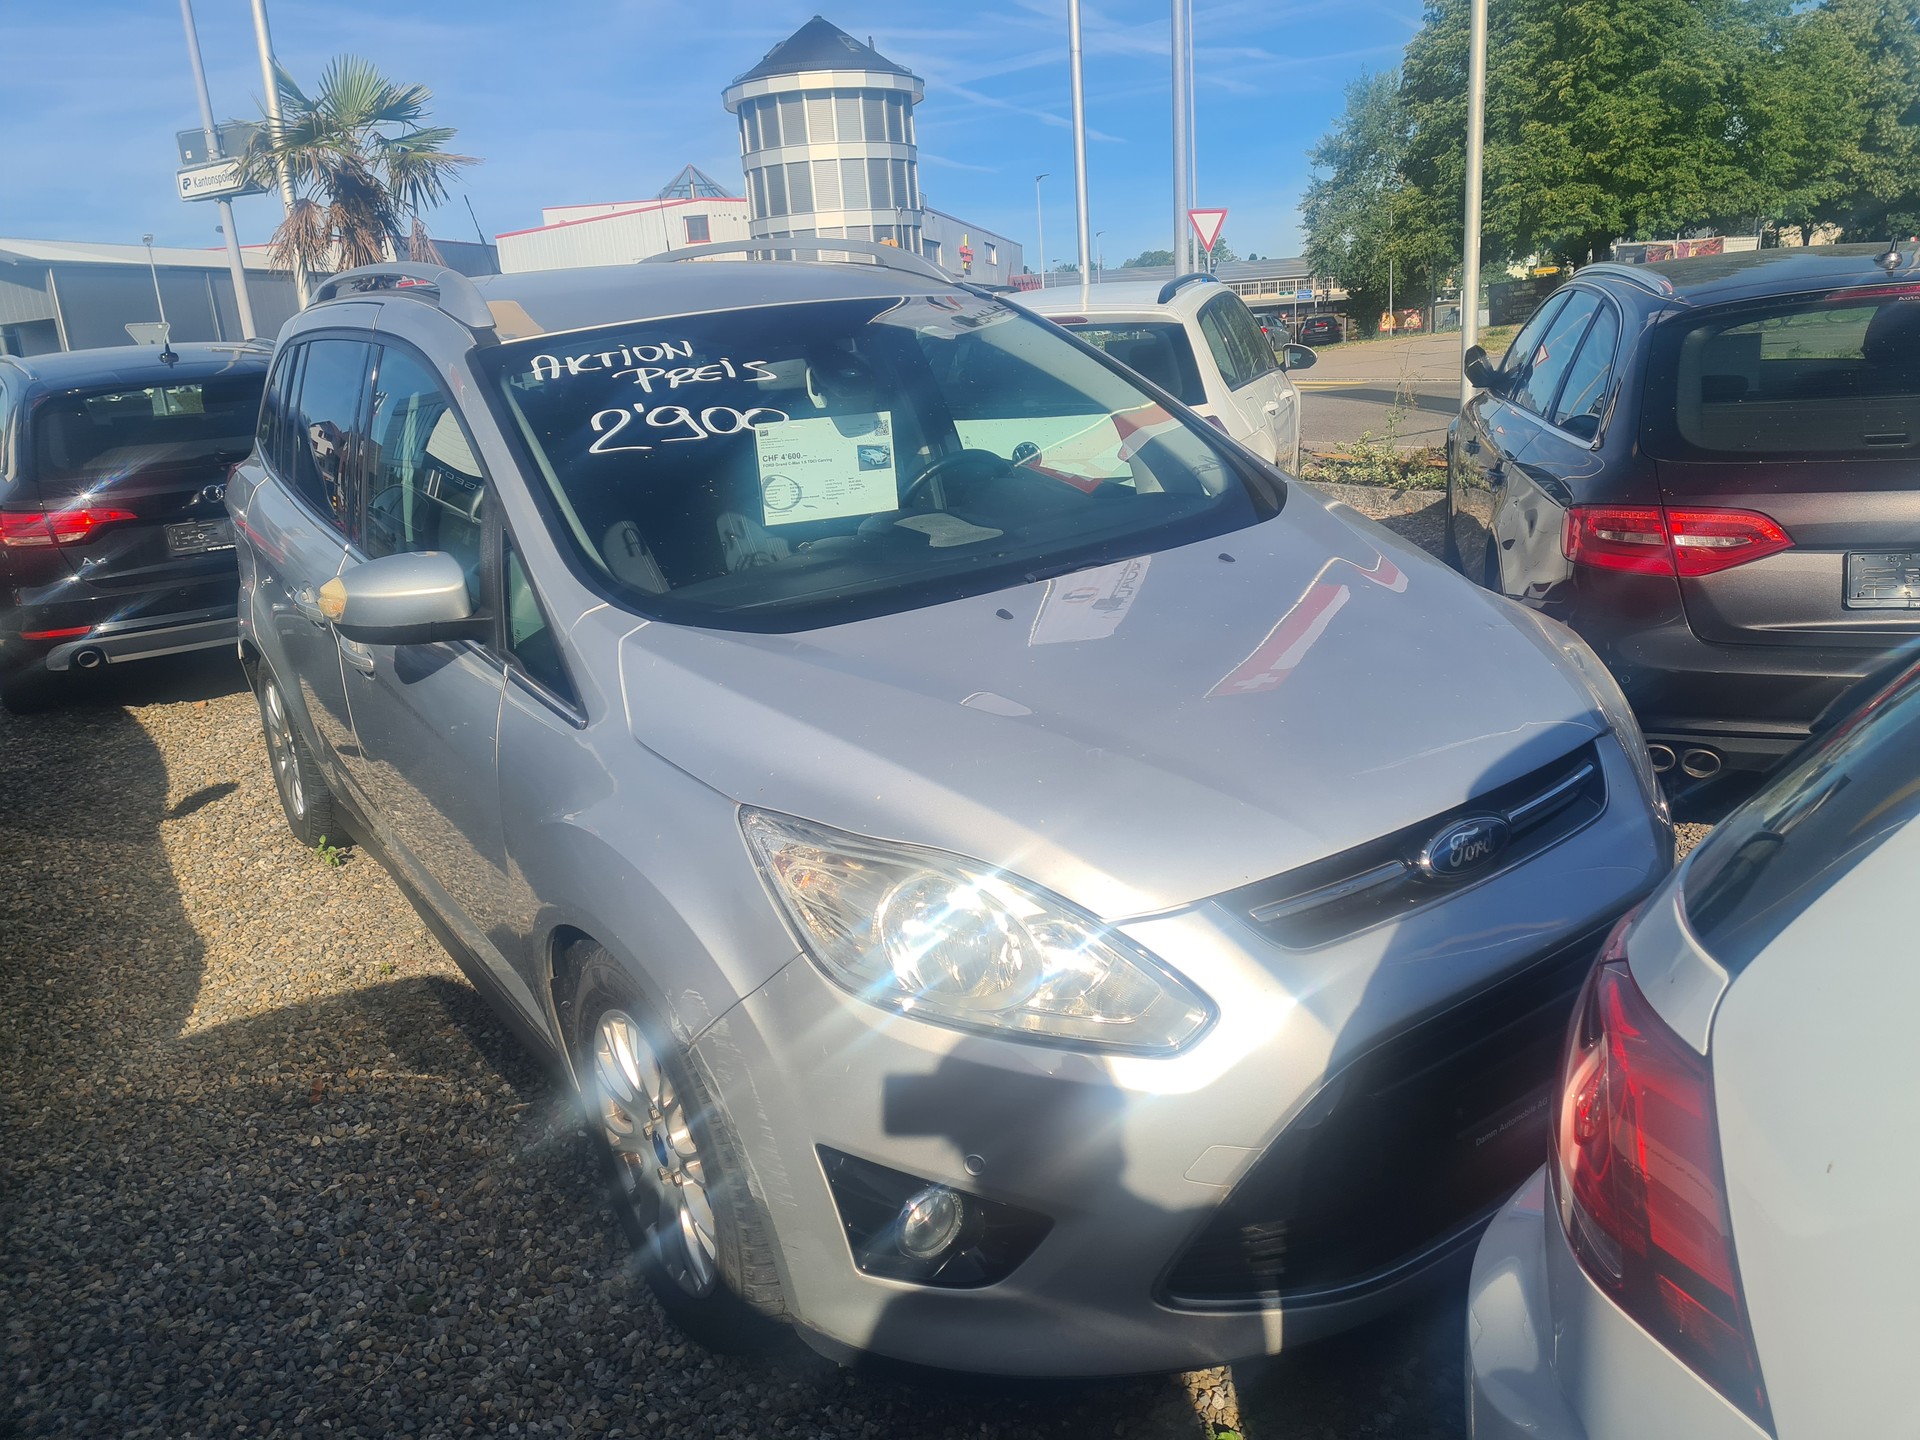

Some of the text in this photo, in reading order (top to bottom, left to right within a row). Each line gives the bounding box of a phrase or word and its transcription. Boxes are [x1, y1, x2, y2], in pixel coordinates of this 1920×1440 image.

[530, 340, 693, 381] AKTION
[611, 357, 778, 393] PREIS
[588, 402, 790, 454] 2'900
[762, 454, 779, 463] CHF
[1449, 827, 1494, 868] Ford
